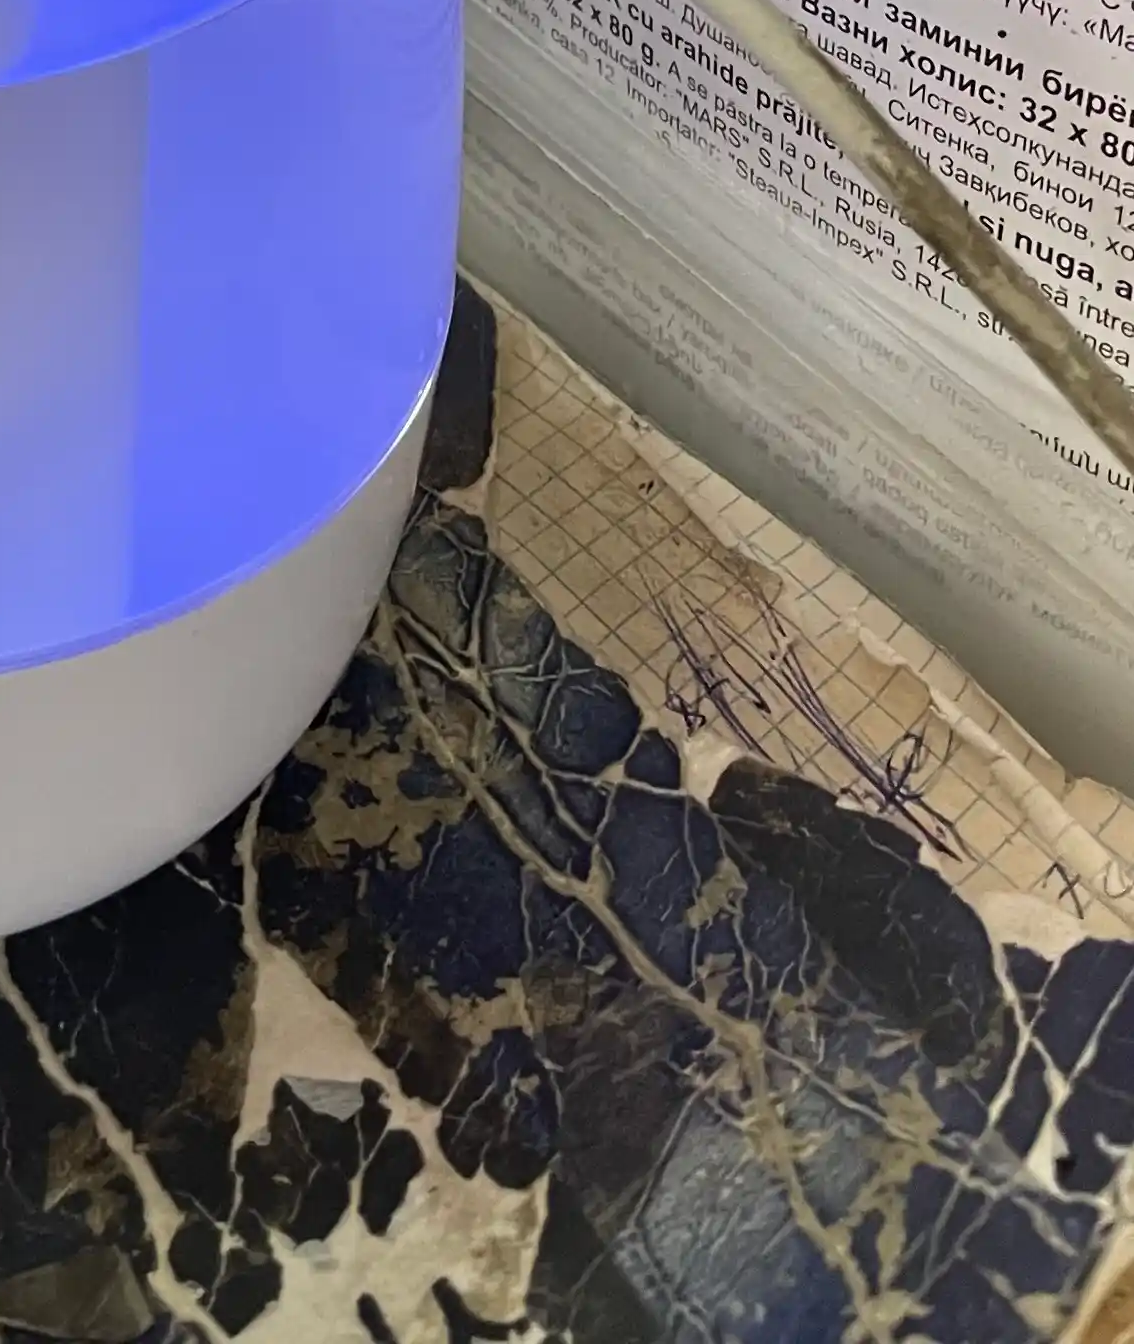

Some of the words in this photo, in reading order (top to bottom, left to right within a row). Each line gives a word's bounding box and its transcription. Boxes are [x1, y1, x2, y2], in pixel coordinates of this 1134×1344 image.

[590, 4, 604, 28] x
[609, 13, 634, 48] 80
[641, 42, 661, 69] g.
[667, 60, 683, 84] A
[687, 76, 709, 101] se
[780, 132, 797, 161] la
[803, 153, 817, 171] o
[884, 2, 1025, 82] заминии
[627, 3, 654, 33] cu
[660, 25, 749, 96] arahide
[1014, 231, 1103, 293] nuga,
[888, 99, 996, 173] Ситенка,
[1013, 160, 1095, 213] бинои
[898, 39, 1007, 112] холис:
[1019, 96, 1058, 134] 32
[1100, 131, 1134, 168] 80
[835, 195, 902, 256] Rusia,
